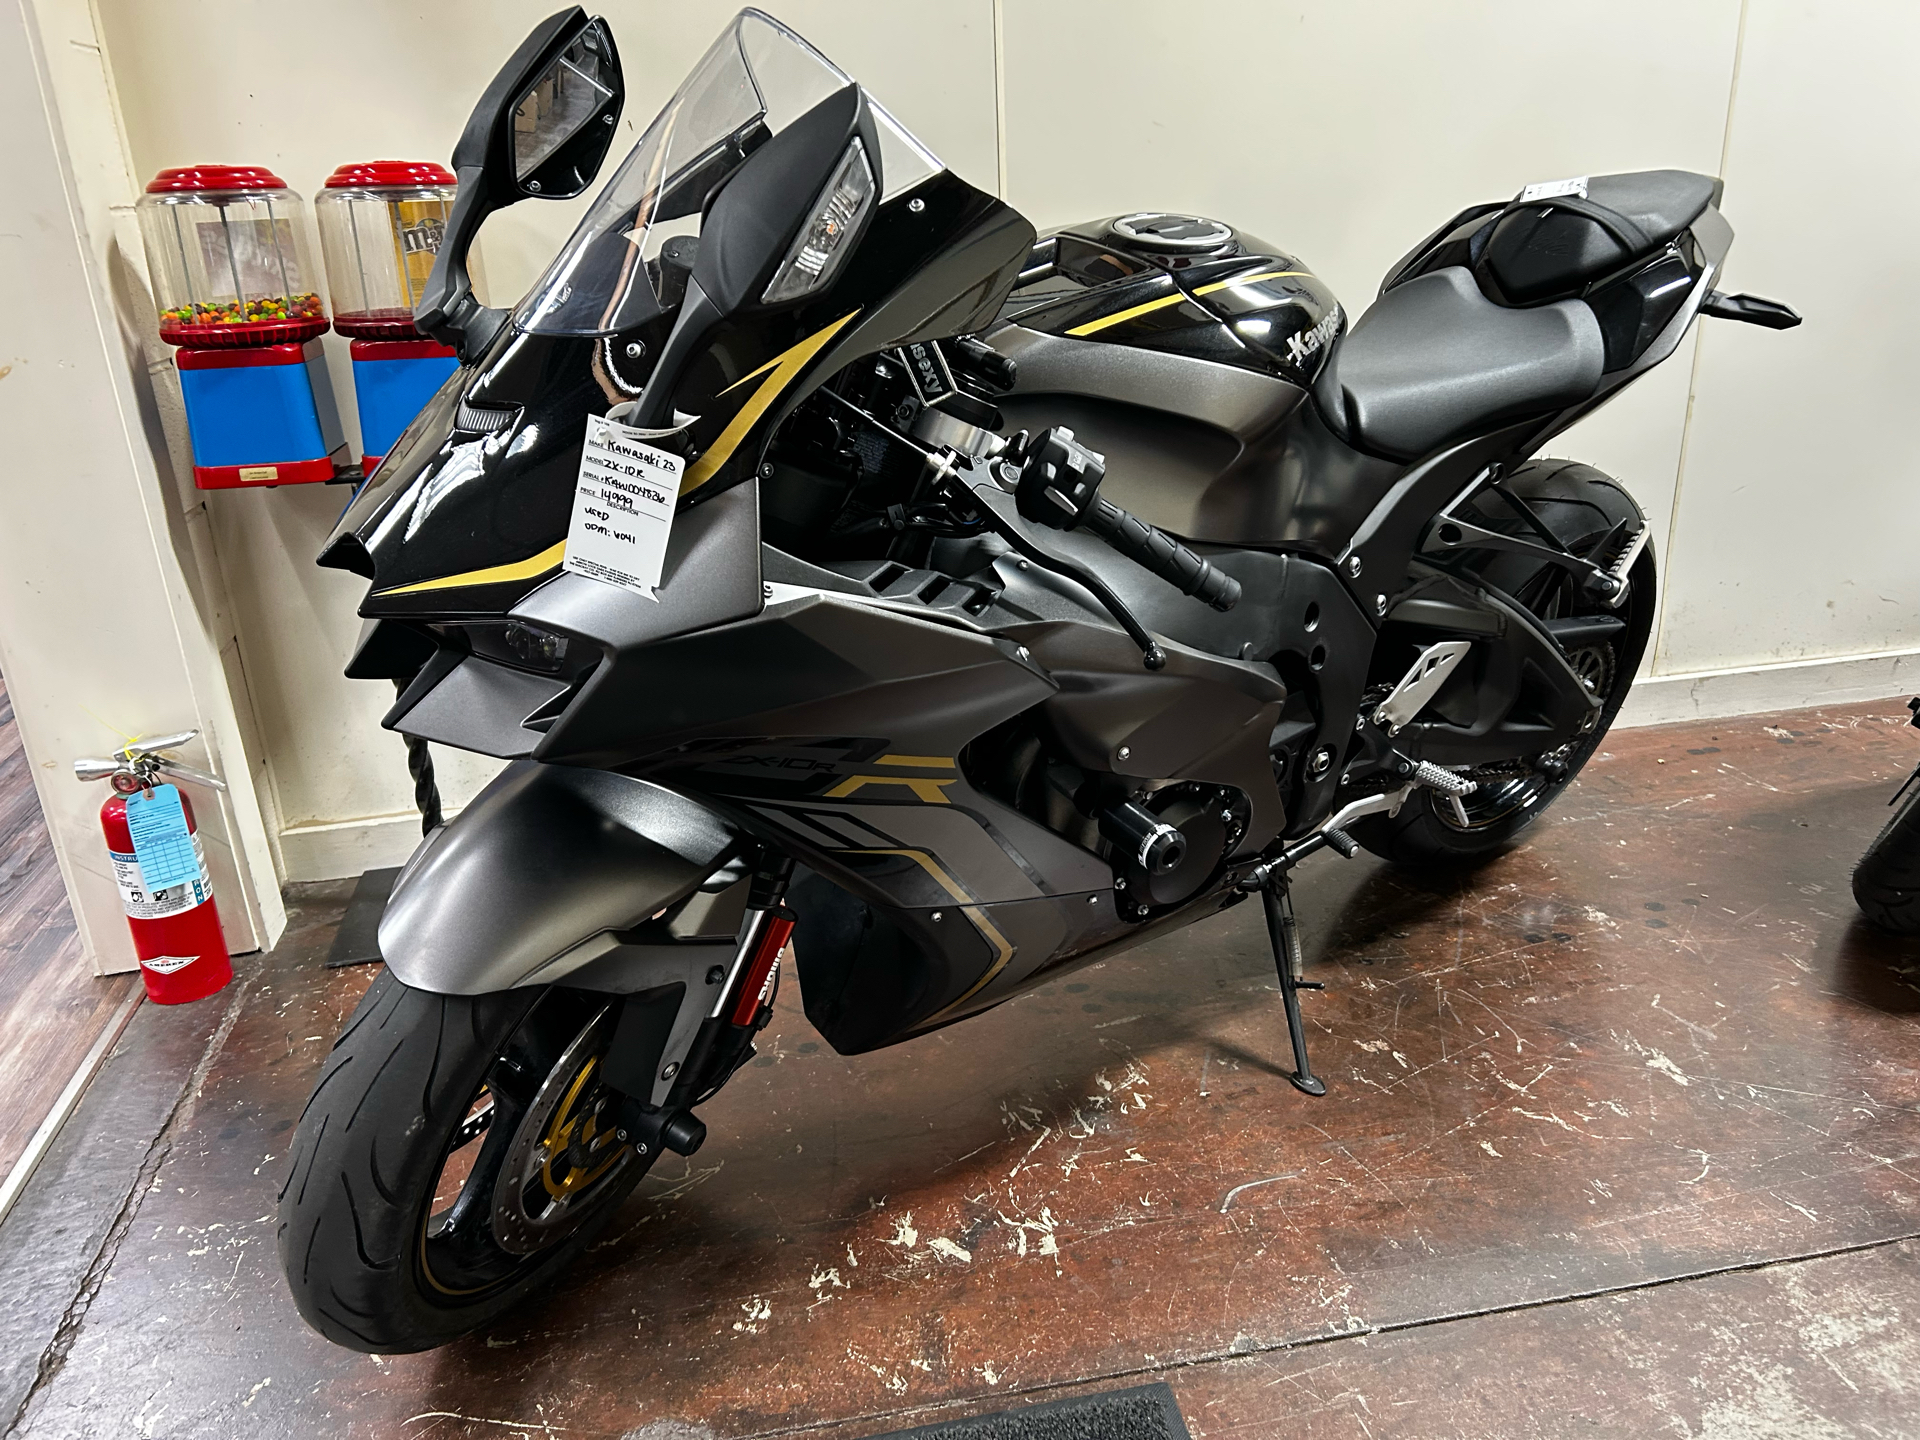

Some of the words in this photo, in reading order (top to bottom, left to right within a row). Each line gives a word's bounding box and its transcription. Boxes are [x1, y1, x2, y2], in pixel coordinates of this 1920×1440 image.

[585, 455, 604, 466] MODEL
[607, 439, 661, 467] Kawasaki
[663, 459, 676, 472] 23
[580, 486, 596, 496] PRICE
[601, 488, 634, 509] 14999
[607, 501, 639, 517] DESCRIPTION
